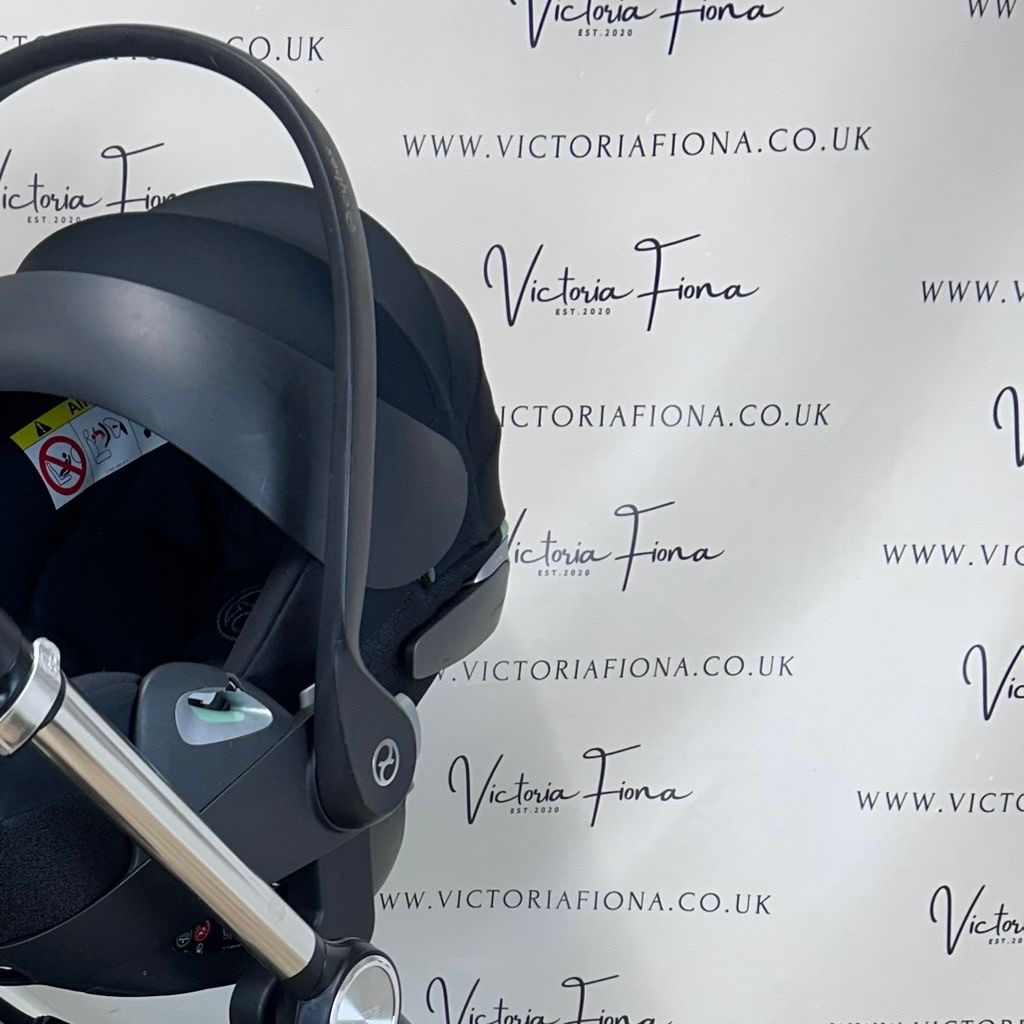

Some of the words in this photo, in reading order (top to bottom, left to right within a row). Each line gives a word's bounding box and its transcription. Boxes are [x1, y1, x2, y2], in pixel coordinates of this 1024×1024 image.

[578, 28, 632, 37] EST.2020
[403, 126, 872, 159] WWW.VICTORIAFIONA.CO.UK
[483, 244, 632, 327] Victoria
[634, 234, 759, 332] Fiona
[614, 501, 725, 592] Fiona
[448, 754, 580, 825] Victoria
[582, 744, 693, 828] Fiona
